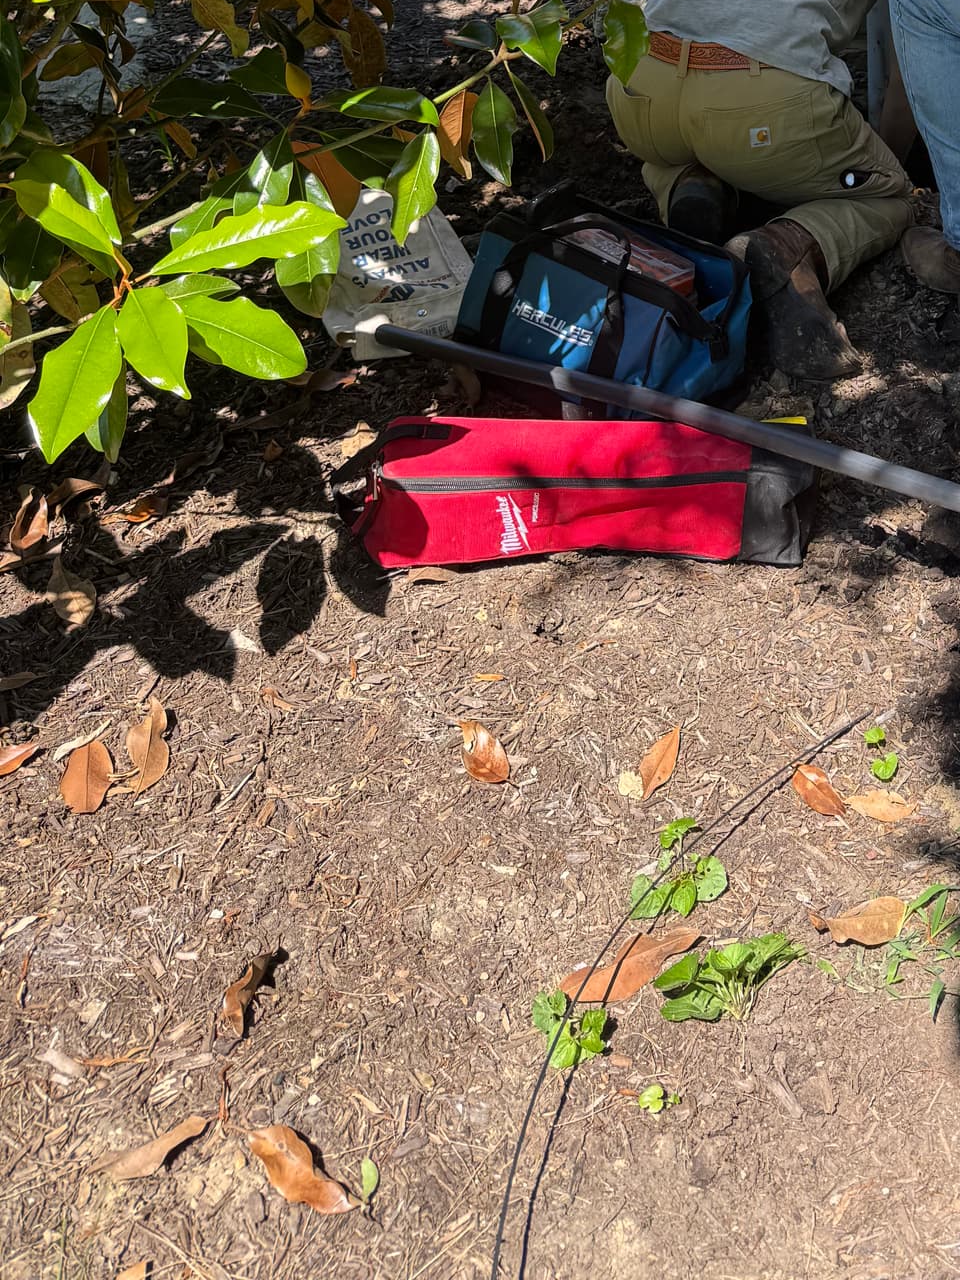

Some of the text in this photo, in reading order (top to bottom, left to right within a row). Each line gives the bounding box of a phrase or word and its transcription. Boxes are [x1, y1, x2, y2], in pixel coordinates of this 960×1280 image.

[352, 244, 412, 268] WEAR
[352, 256, 430, 289] ALWAYS
[512, 298, 594, 343] HERCULES
[496, 495, 523, 554] Milwaukee
